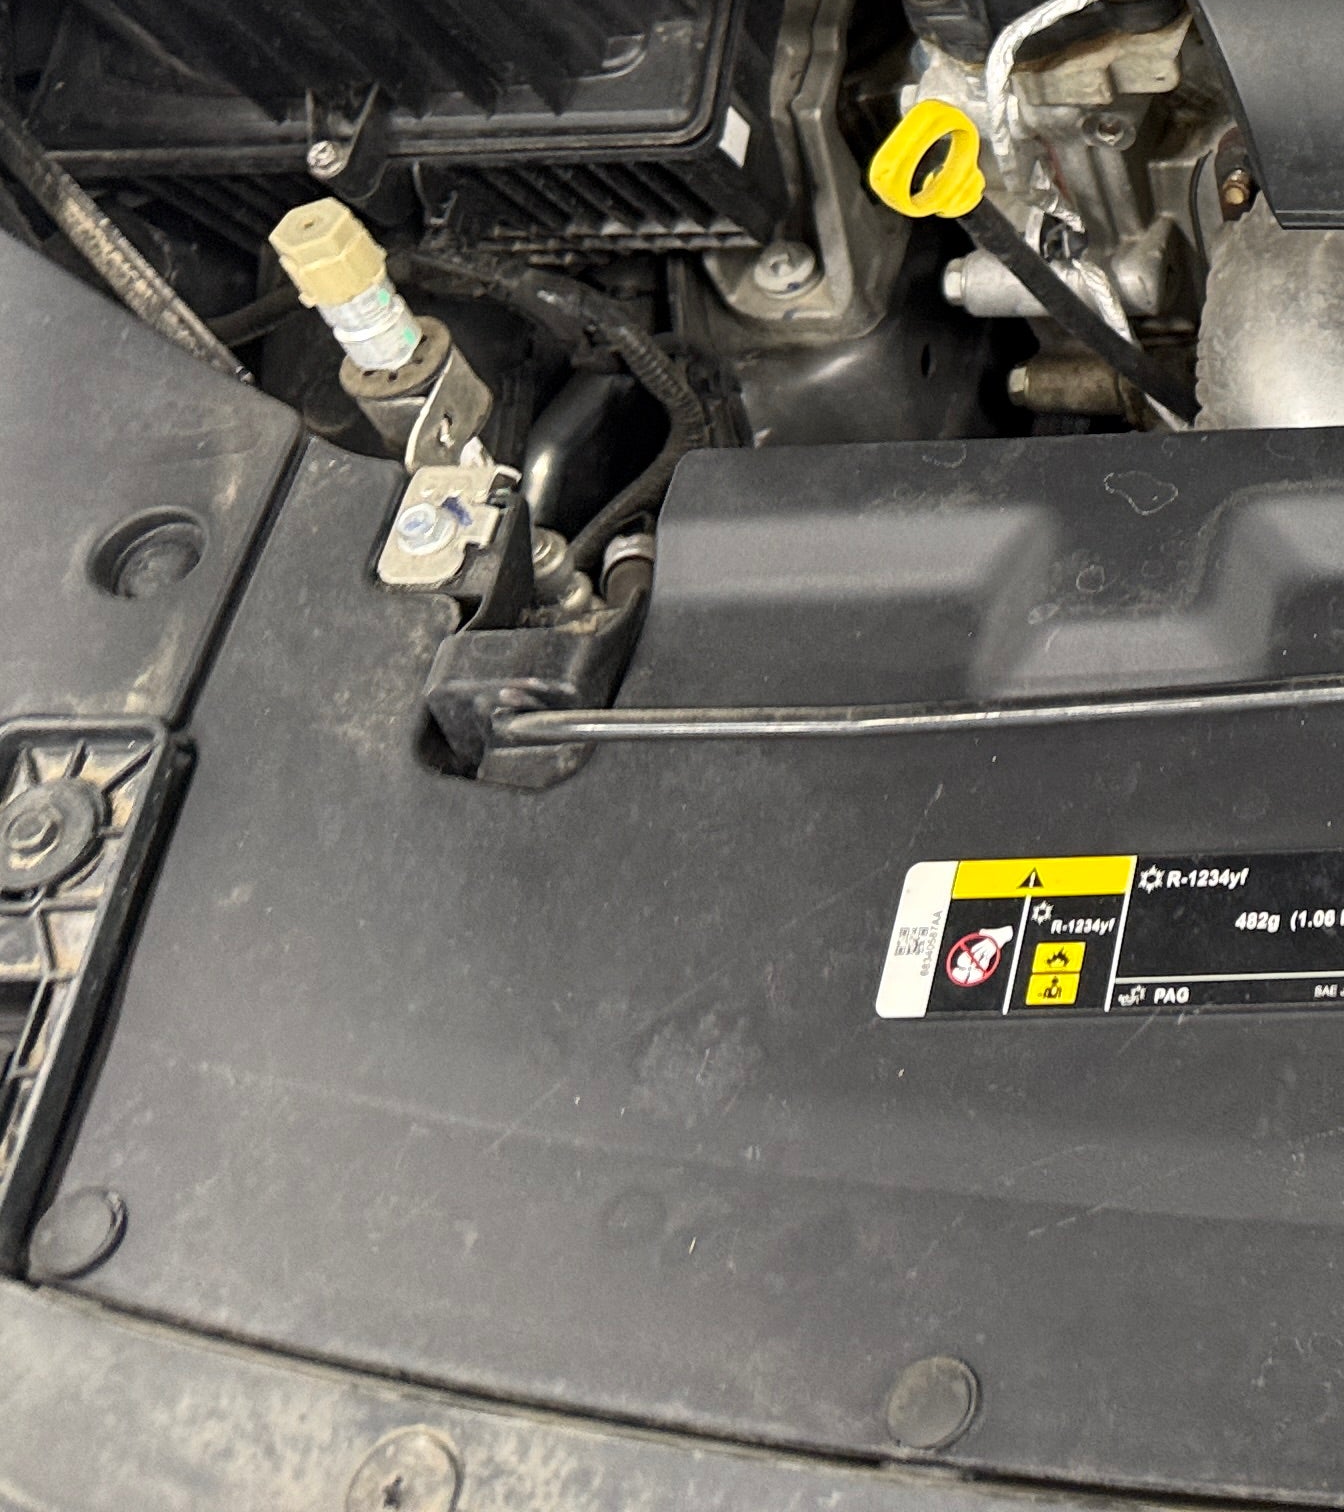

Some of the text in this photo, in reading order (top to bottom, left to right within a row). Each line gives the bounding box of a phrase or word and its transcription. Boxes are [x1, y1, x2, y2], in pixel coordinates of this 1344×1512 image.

[1166, 867, 1250, 891] R-1234yf
[1051, 915, 1116, 936] R-1234yf
[1235, 912, 1281, 933] 482g
[1153, 986, 1190, 1004] PAG
[1314, 984, 1338, 999] SAE
